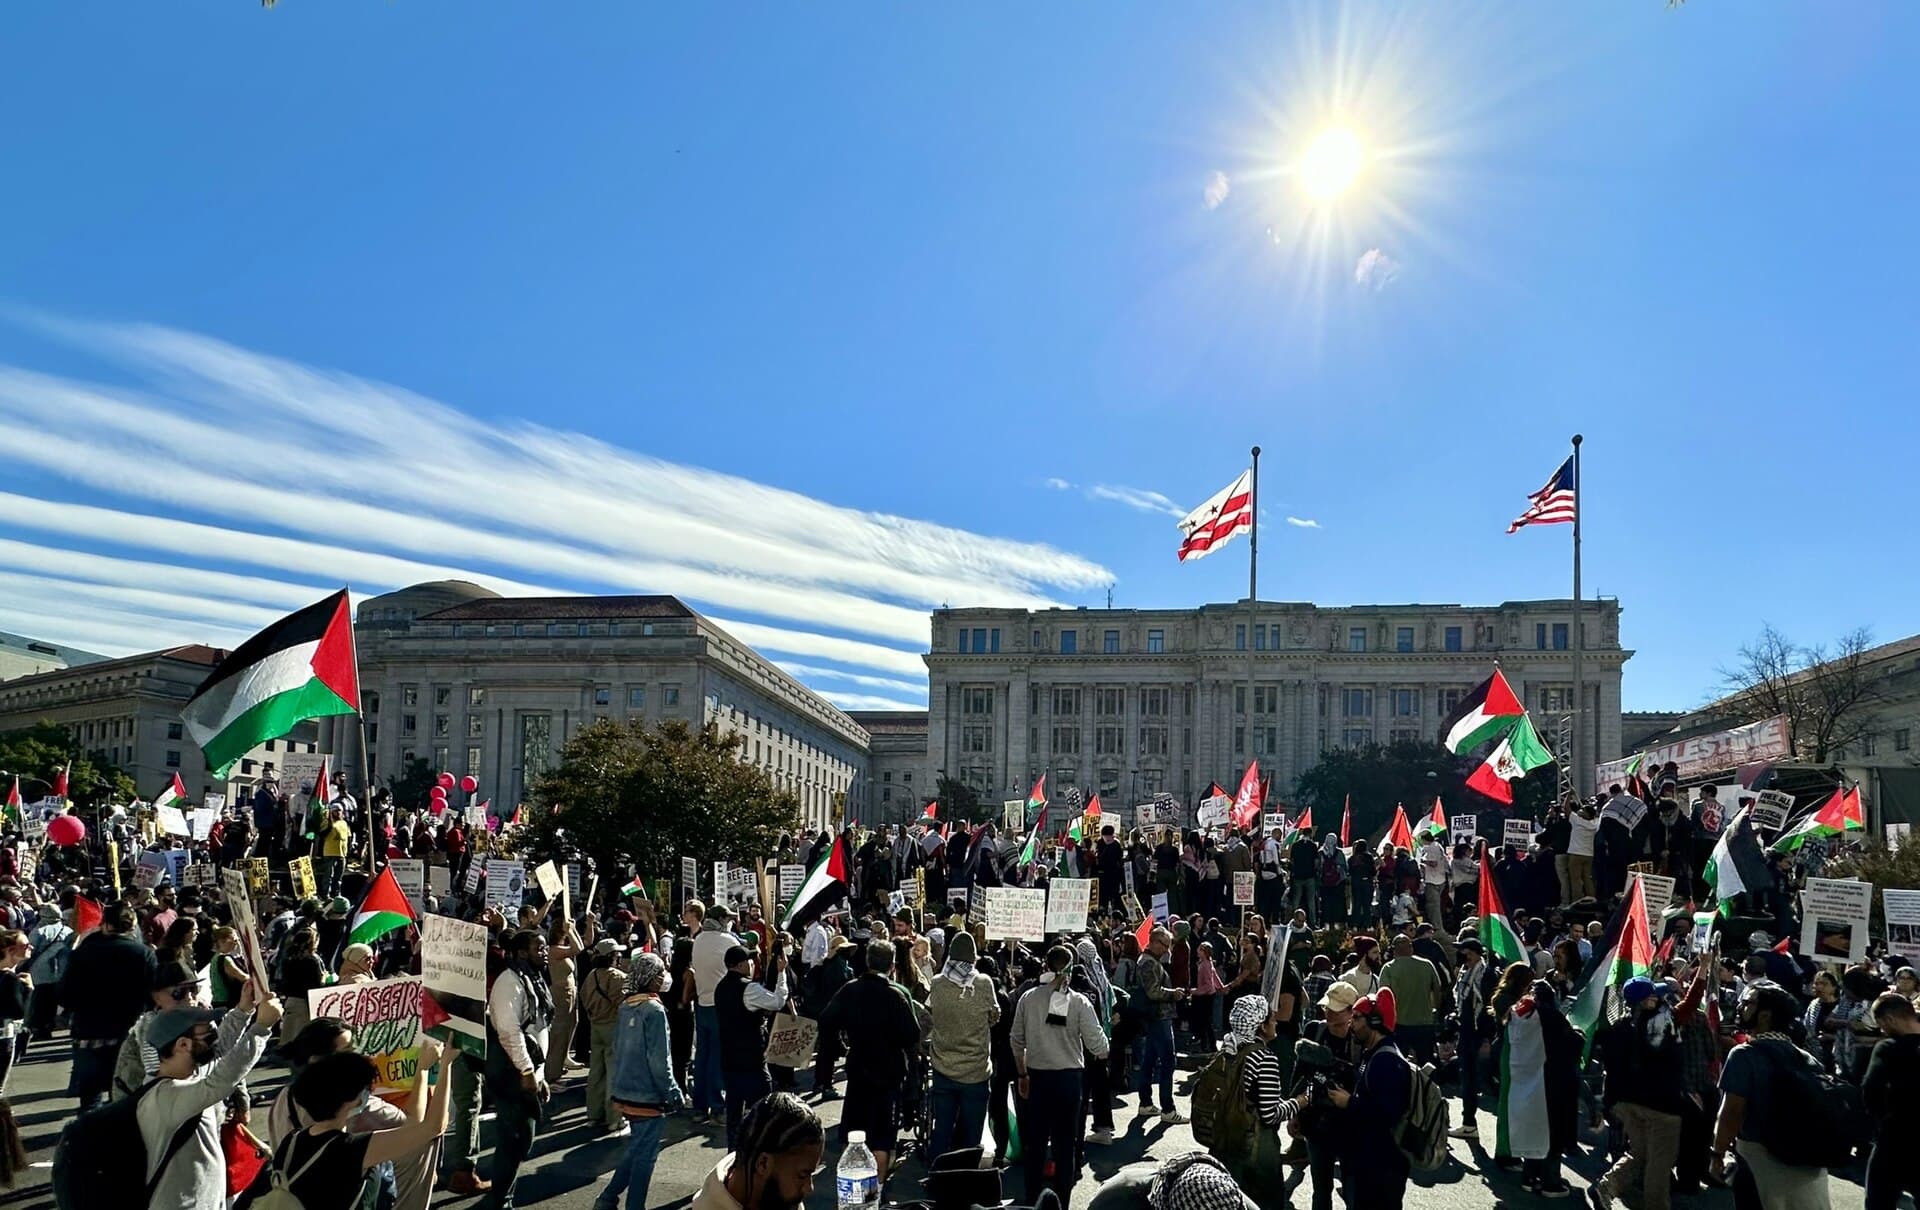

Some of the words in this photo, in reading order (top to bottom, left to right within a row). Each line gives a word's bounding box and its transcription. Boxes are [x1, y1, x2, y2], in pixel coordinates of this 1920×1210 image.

[1154, 798, 1173, 813] FREE
[1454, 816, 1474, 826] FREE
[1082, 822, 1100, 836] LIVE
[317, 981, 423, 1026] CEASEFIRE
[351, 1015, 419, 1057] NOW
[772, 1029, 799, 1043] FREE
